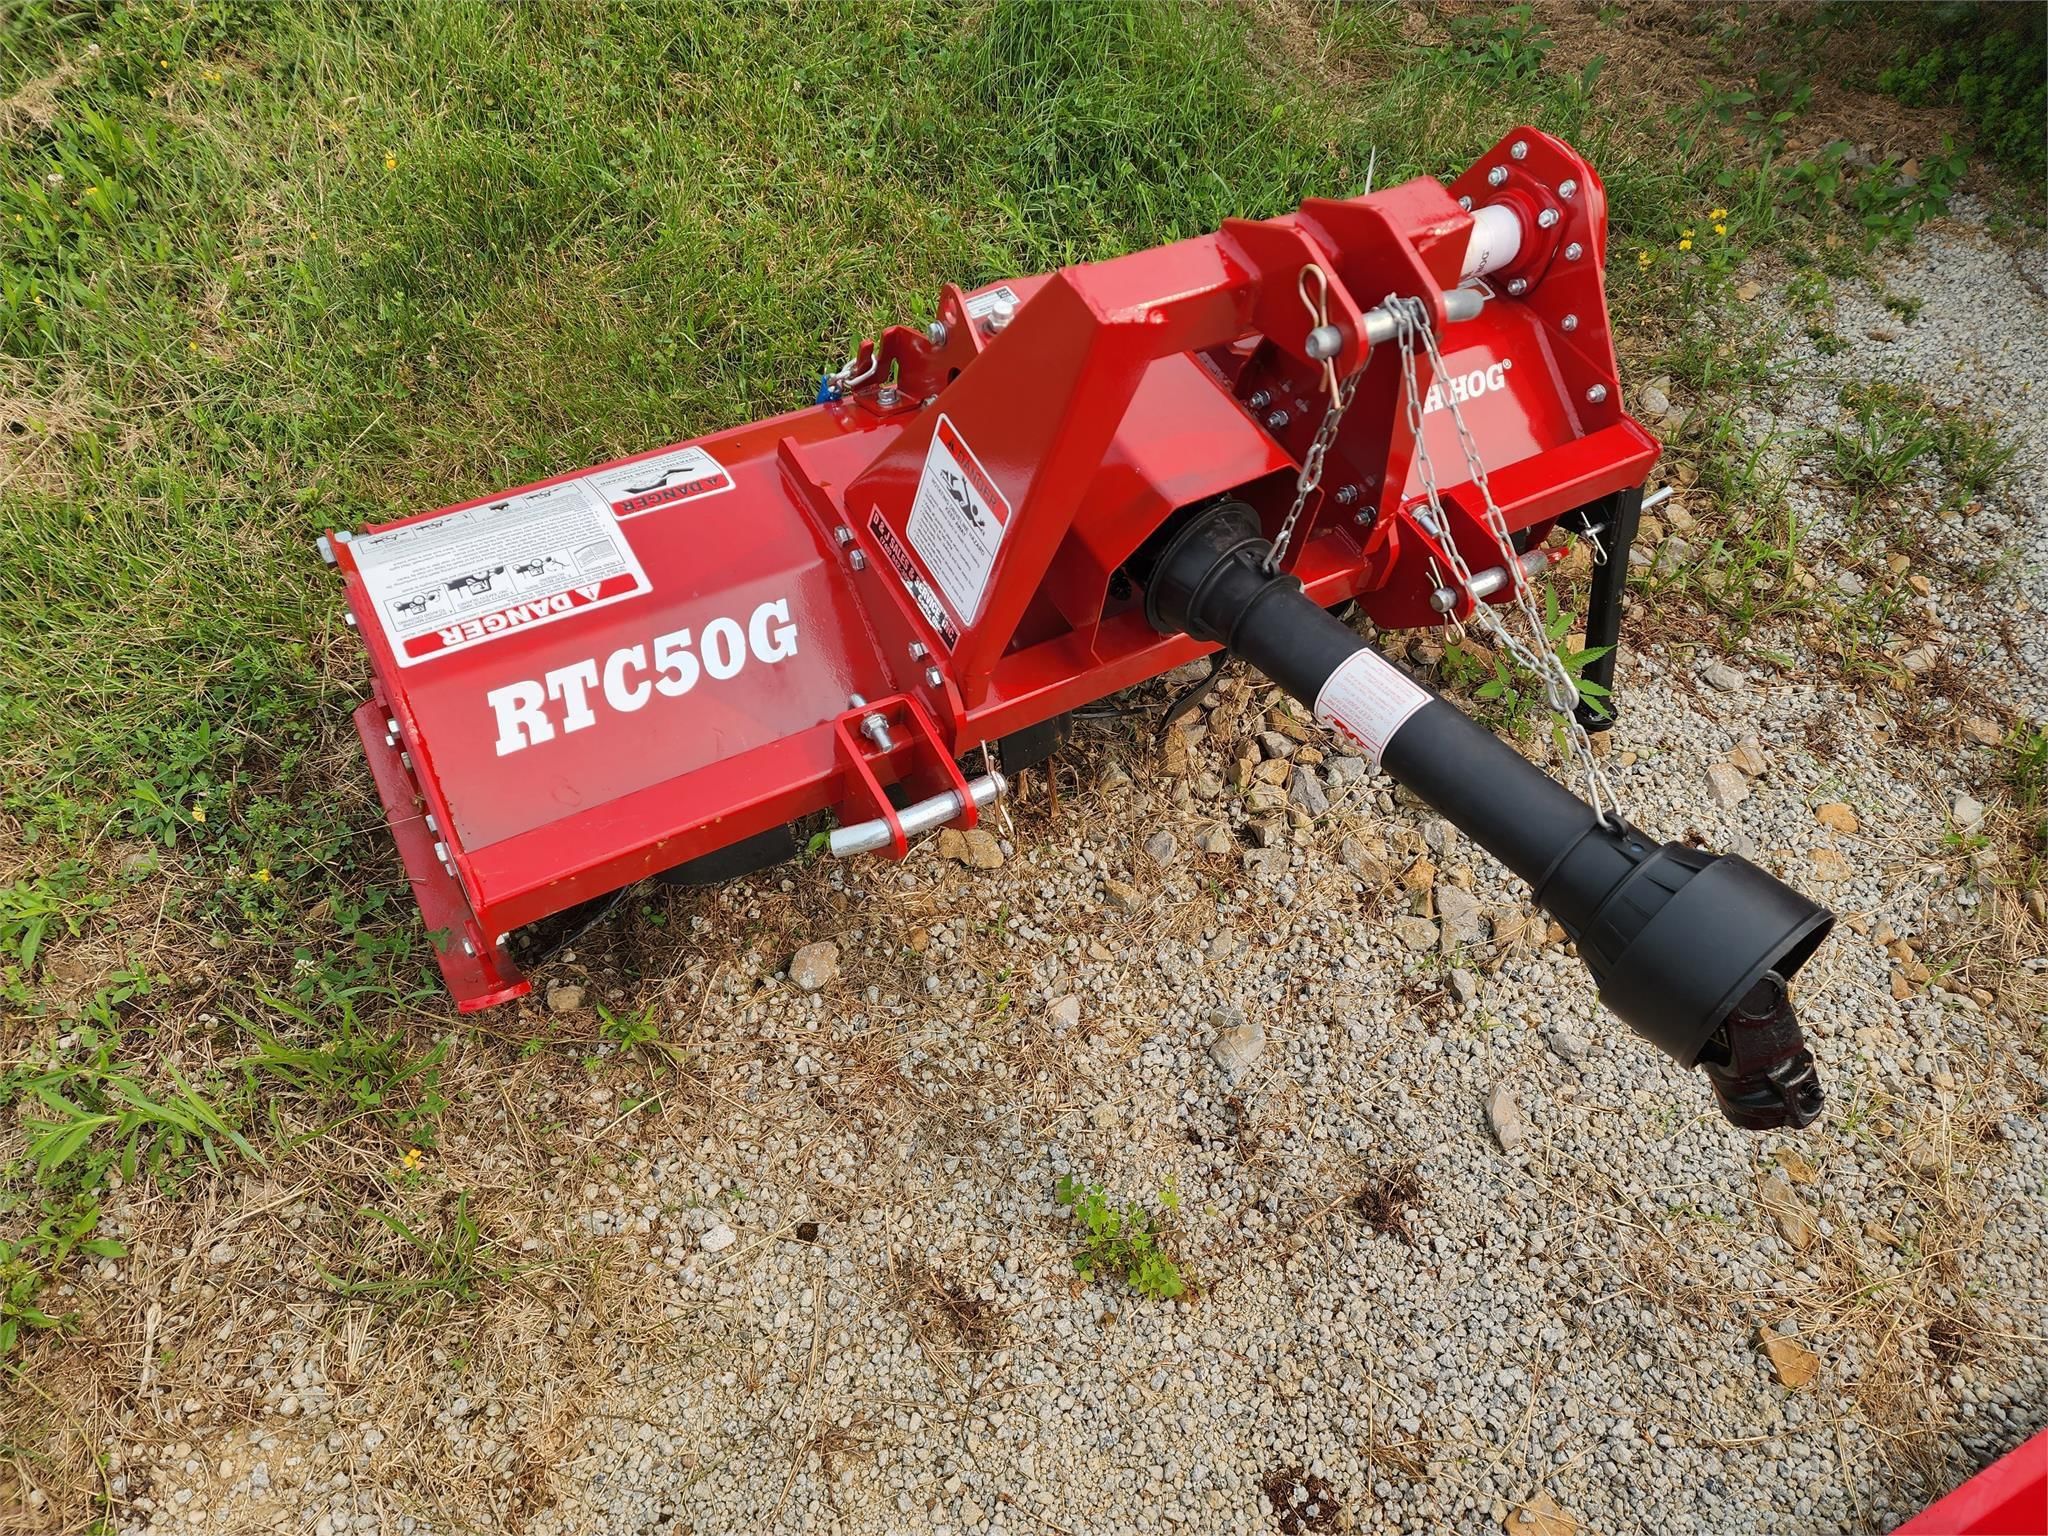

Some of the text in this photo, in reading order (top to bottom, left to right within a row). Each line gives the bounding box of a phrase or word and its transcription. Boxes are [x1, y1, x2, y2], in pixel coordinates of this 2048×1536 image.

[890, 538, 910, 570] SALES
[436, 591, 574, 647] DANGER
[487, 598, 798, 756] RTC50G
